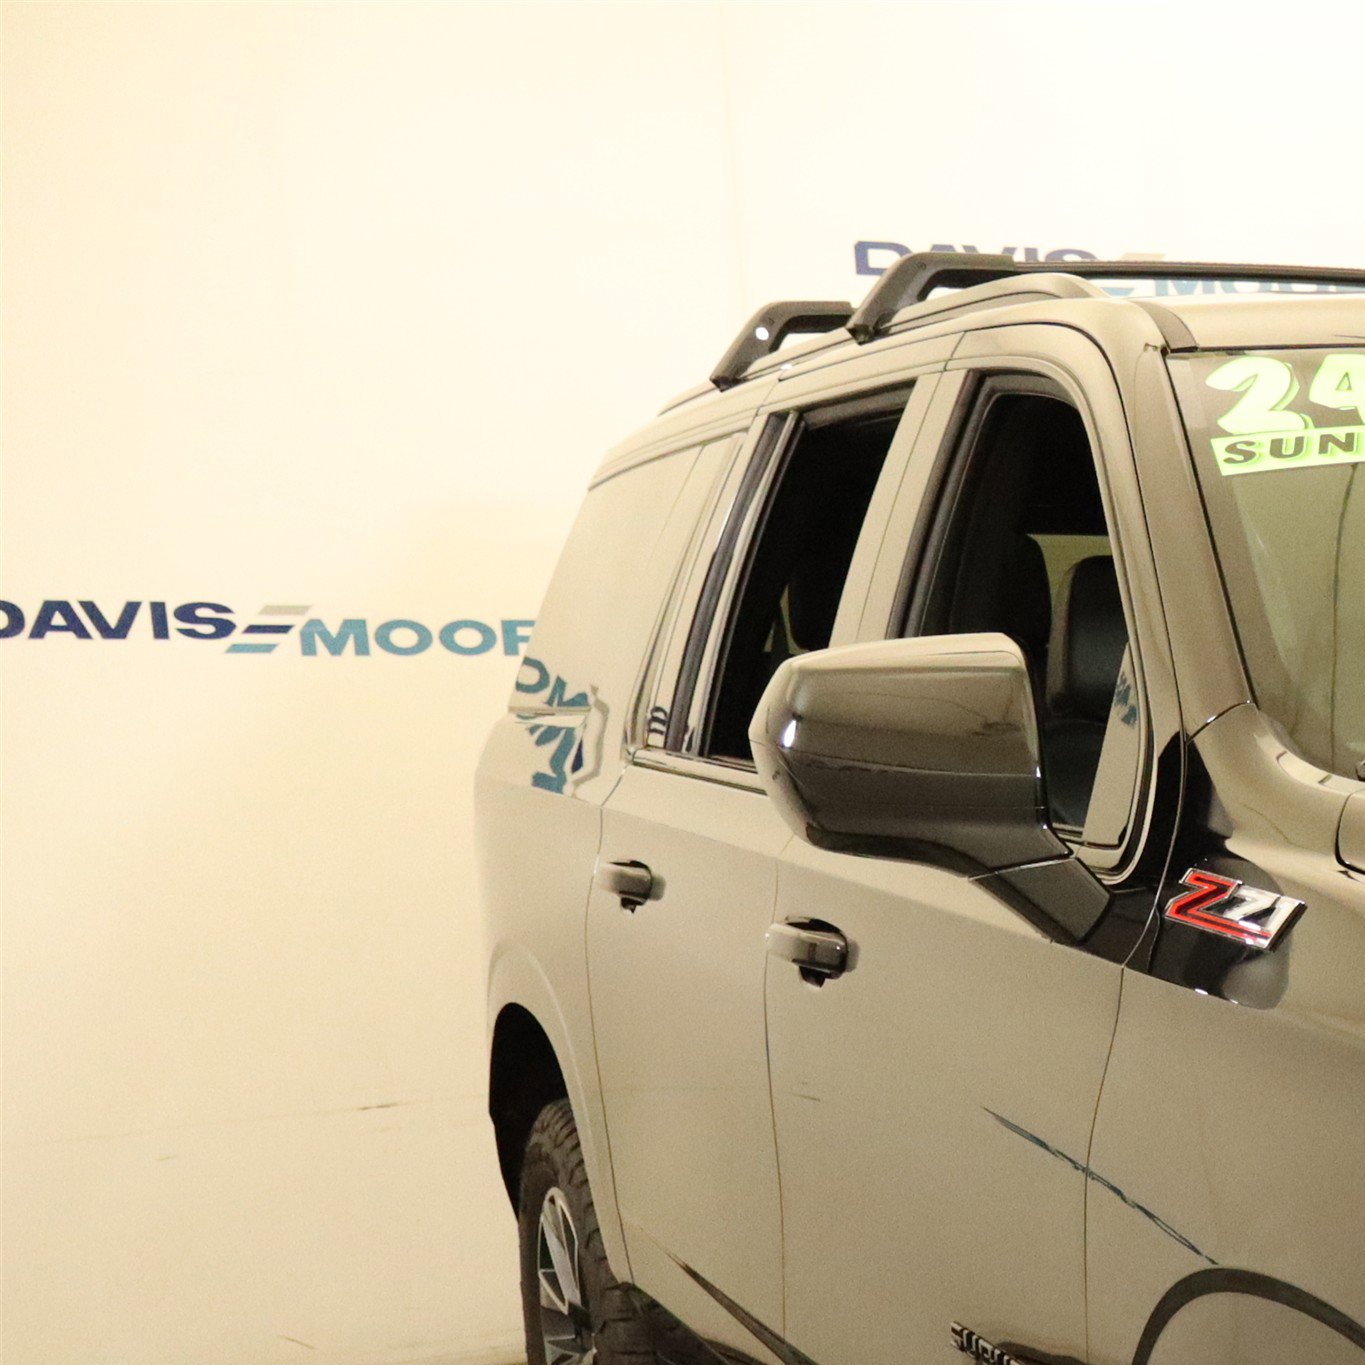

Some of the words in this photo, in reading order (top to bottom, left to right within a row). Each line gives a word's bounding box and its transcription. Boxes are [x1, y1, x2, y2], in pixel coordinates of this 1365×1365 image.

[1223, 431, 1356, 465] SUN
[300, 618, 536, 656] MOO
[1164, 867, 1308, 951] Z71
